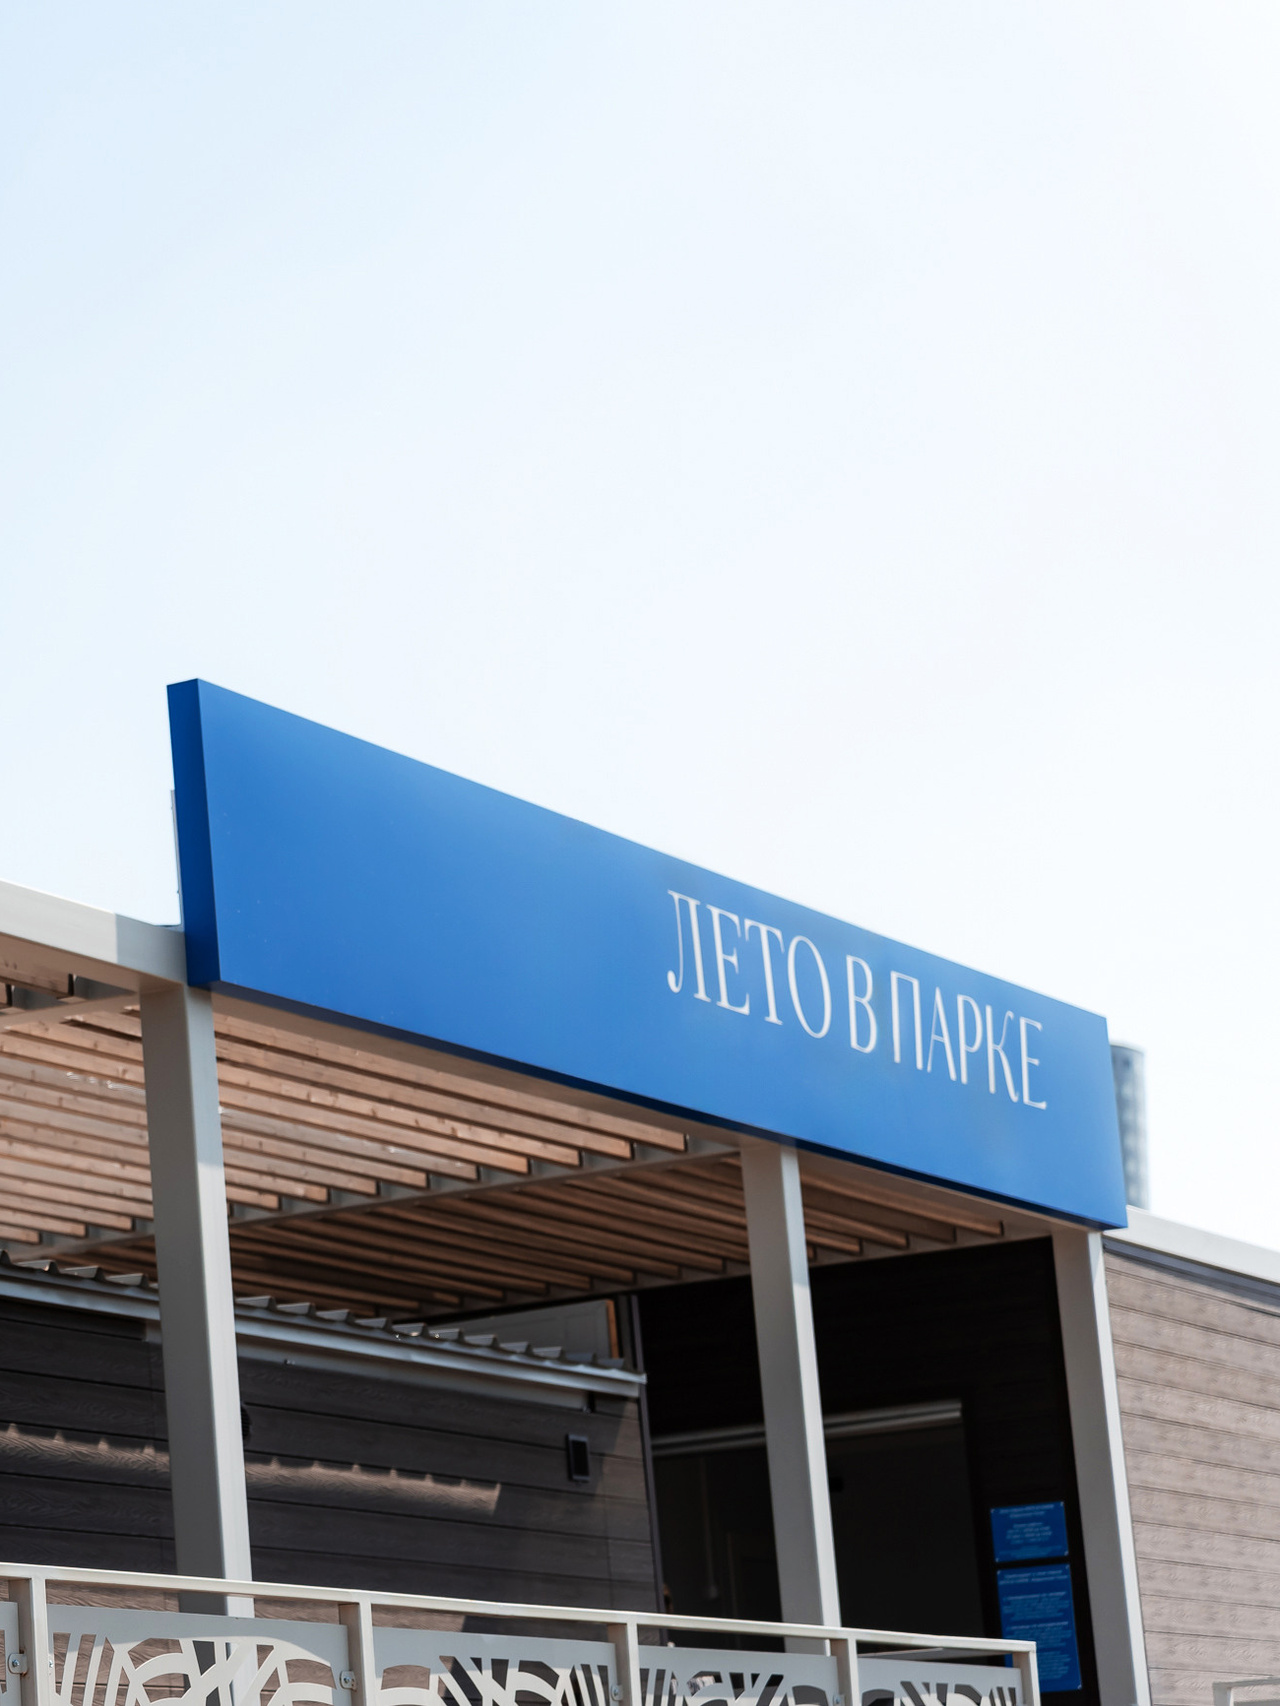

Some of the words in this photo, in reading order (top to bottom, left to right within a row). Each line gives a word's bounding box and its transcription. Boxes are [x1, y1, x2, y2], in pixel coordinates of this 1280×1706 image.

[667, 889, 832, 1038] ЛЕТО
[846, 954, 878, 1054] В
[890, 970, 1047, 1110] ПАРКЕ
